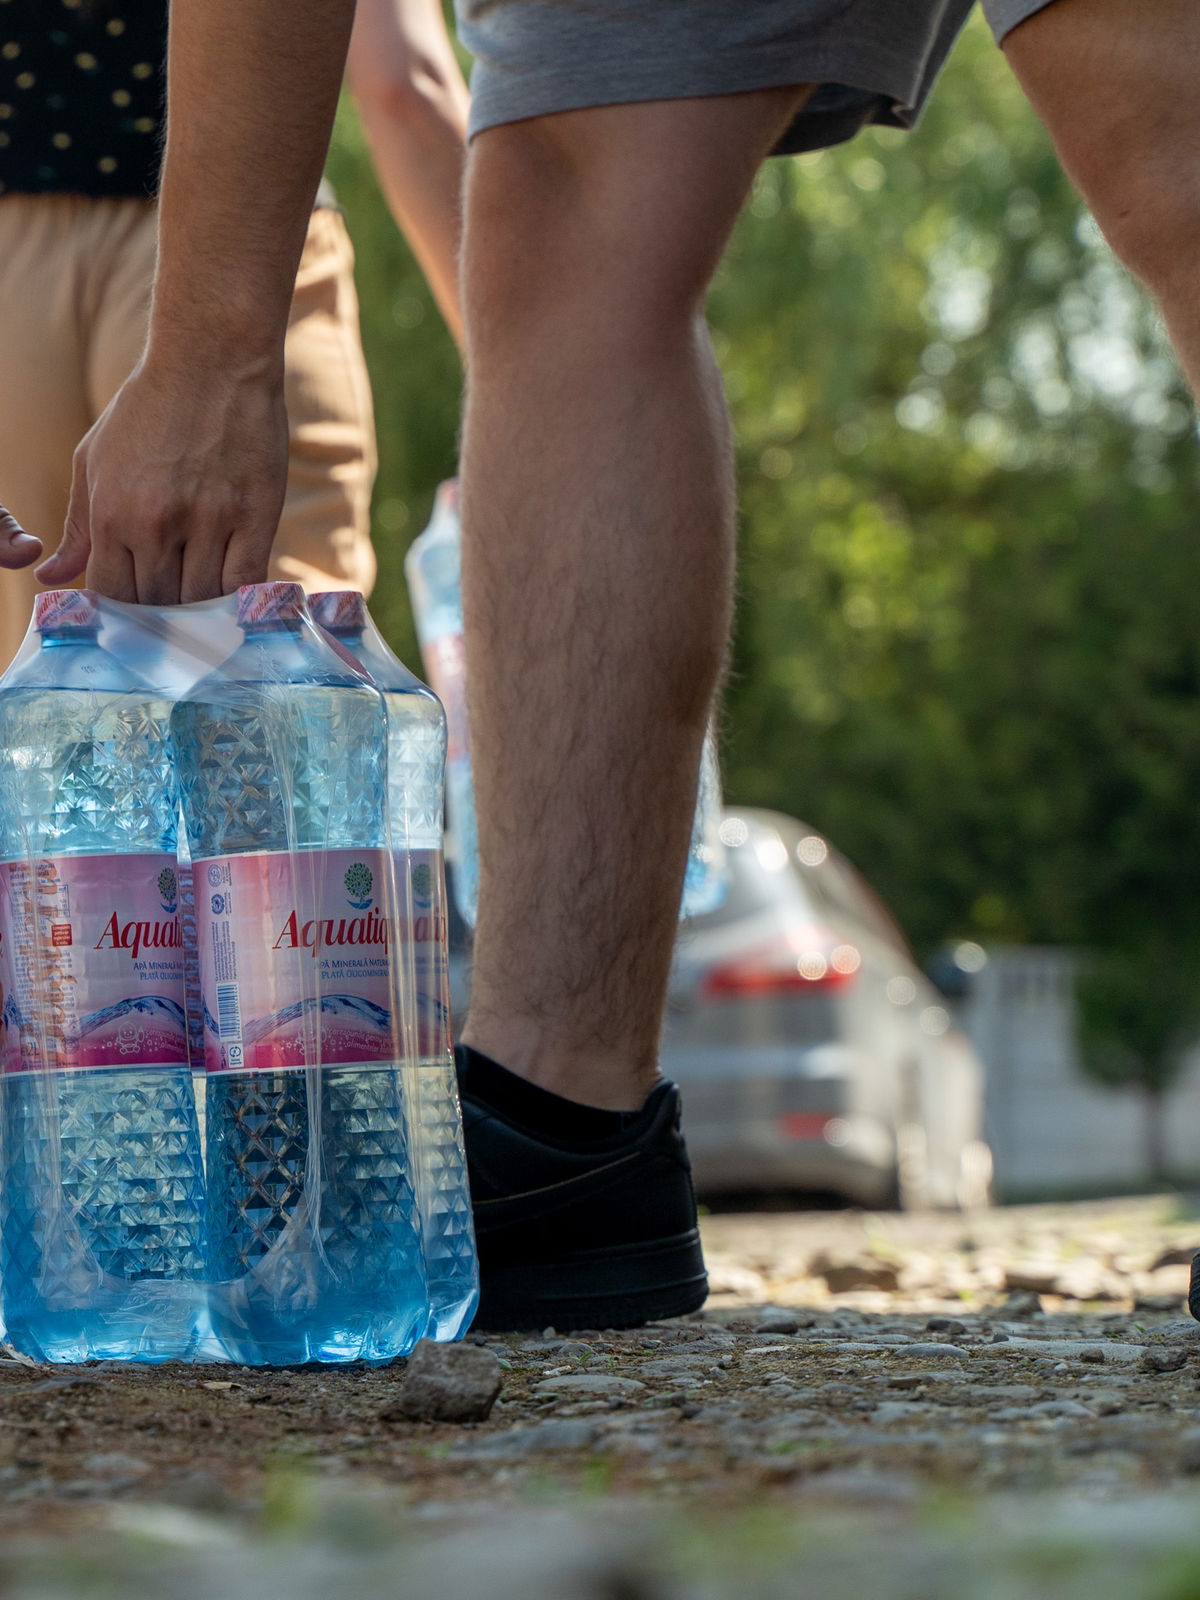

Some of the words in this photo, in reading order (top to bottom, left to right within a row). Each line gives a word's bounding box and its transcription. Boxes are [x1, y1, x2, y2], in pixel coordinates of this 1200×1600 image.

[133, 961, 147, 970] APĂ
[332, 958, 368, 968] MINERALĂ
[140, 971, 159, 981] PLATĂ
[321, 968, 344, 980] PLATĂ
